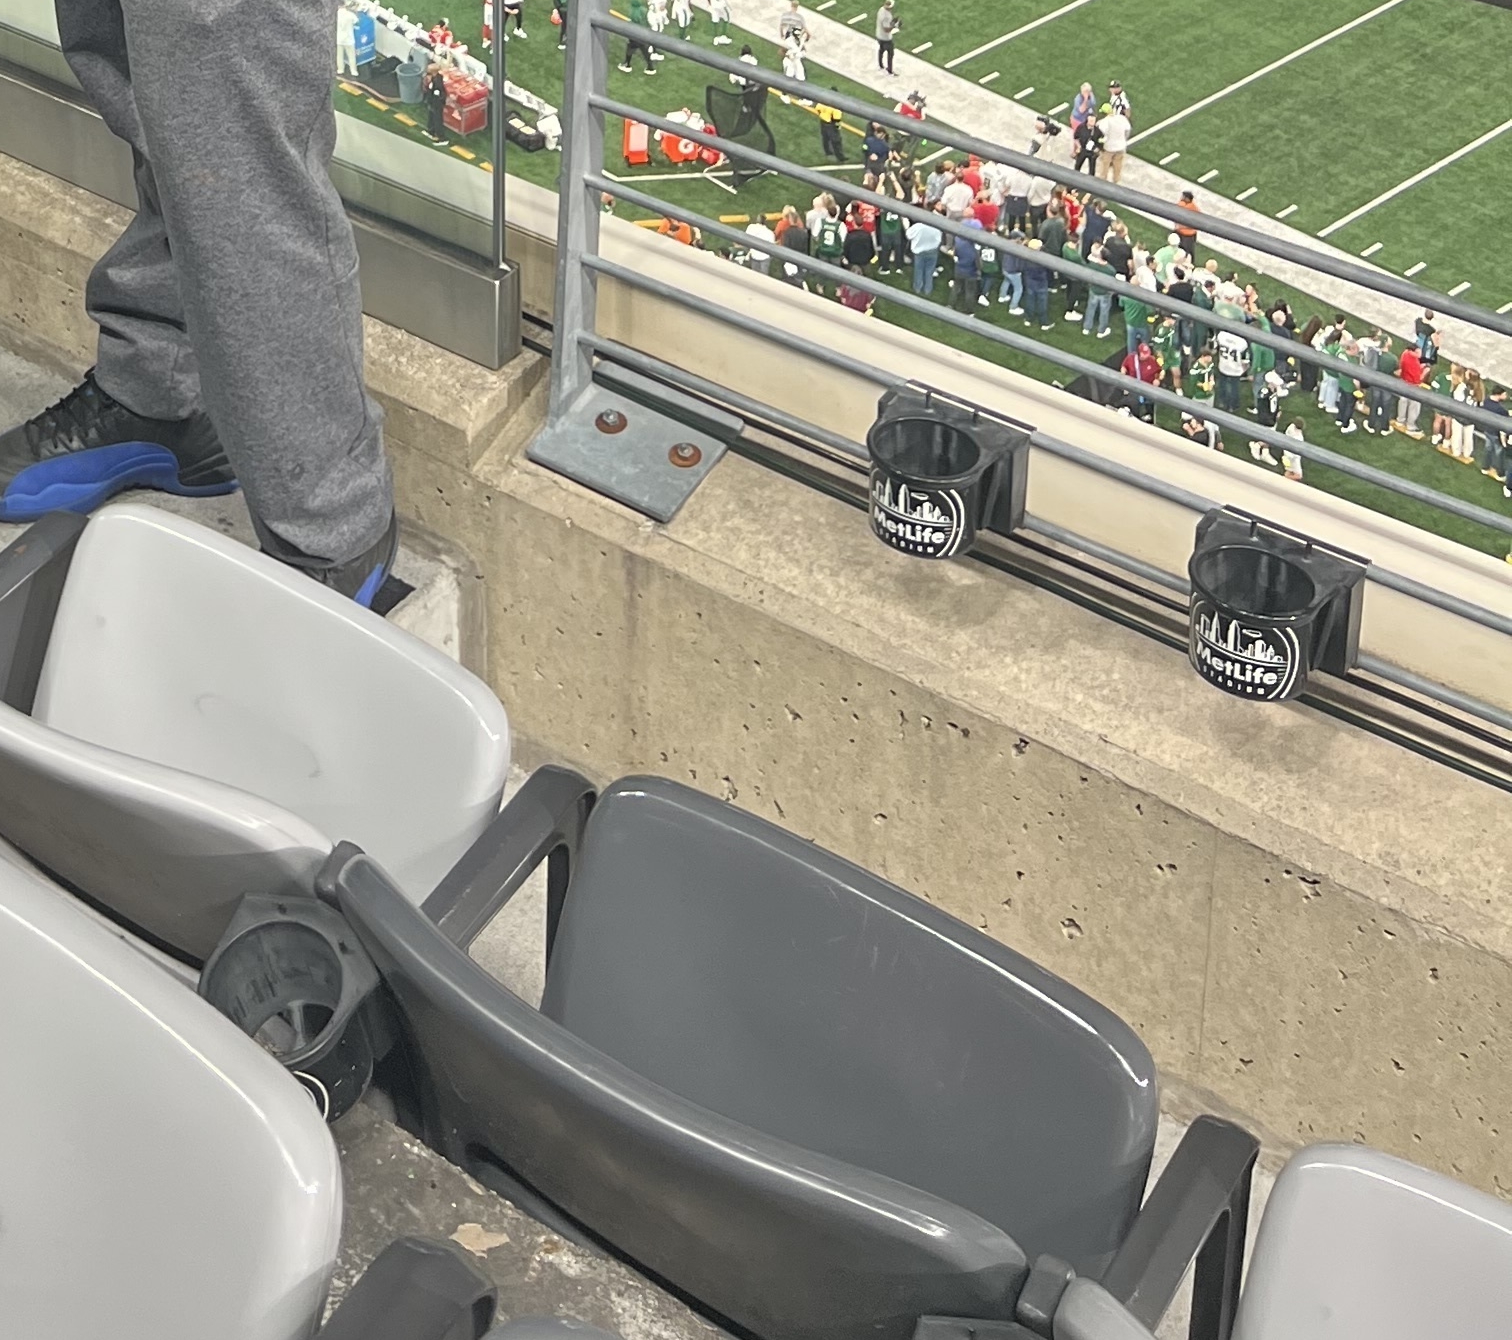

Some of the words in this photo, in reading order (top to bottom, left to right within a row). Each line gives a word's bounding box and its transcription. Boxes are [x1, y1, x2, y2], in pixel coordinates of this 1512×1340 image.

[1218, 345, 1239, 362] 24
[873, 505, 946, 544] MetLife
[1196, 640, 1279, 686] MetLife
